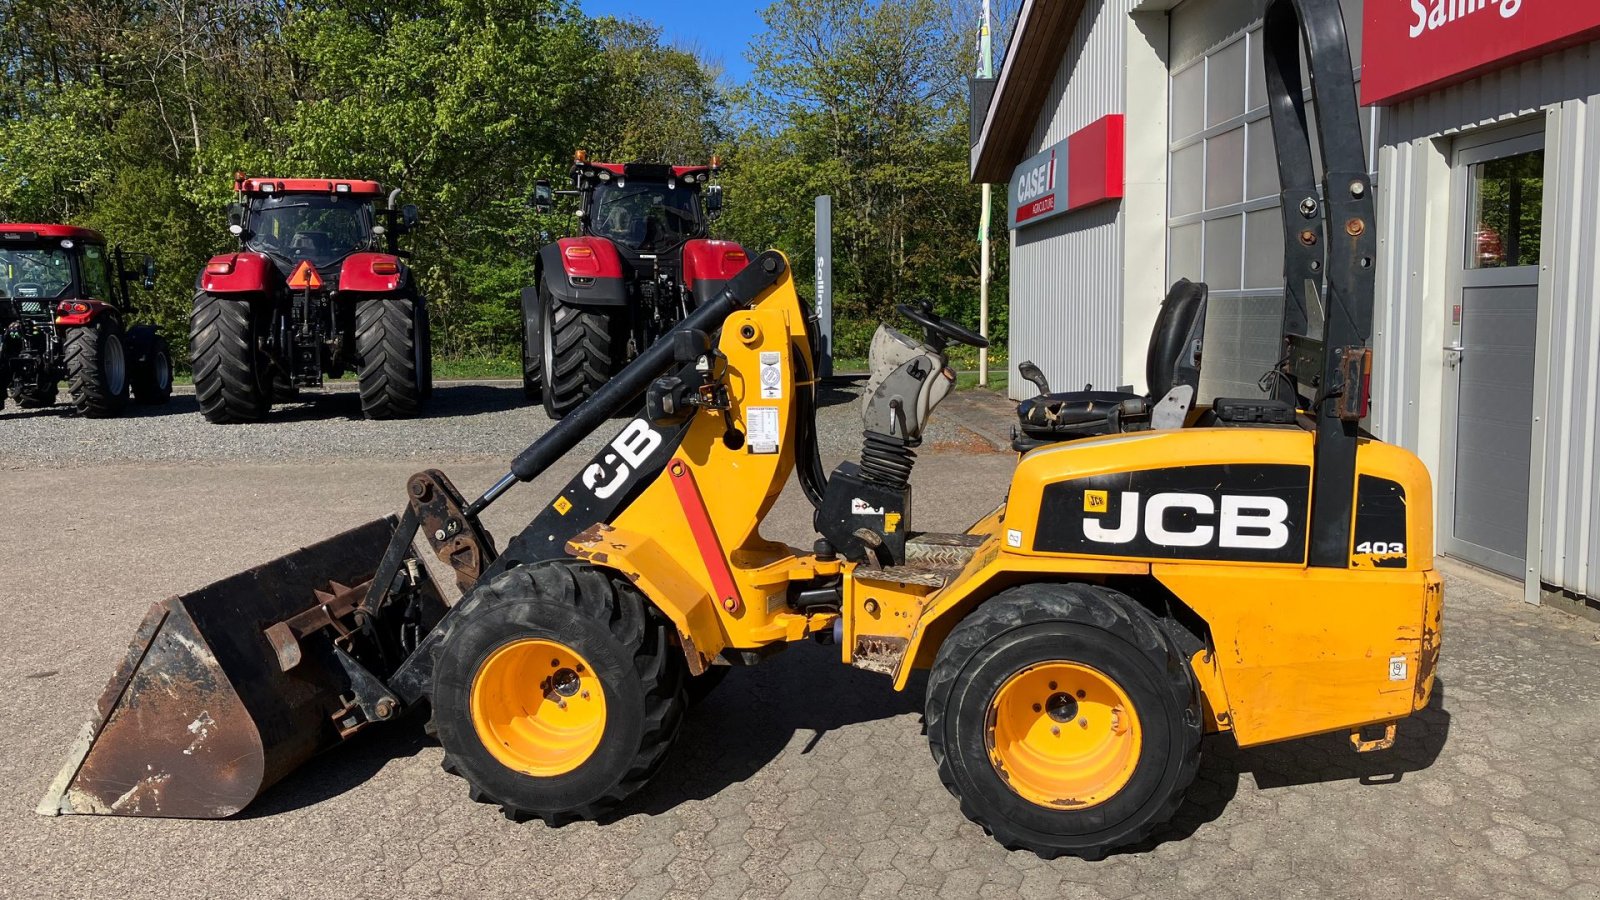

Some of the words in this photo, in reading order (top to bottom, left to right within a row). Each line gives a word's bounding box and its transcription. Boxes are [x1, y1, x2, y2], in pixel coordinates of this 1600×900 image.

[1018, 164, 1045, 203] CASE
[1033, 197, 1054, 214] AGRICULTURE
[1083, 491, 1289, 549] JCB
[1356, 541, 1404, 555] 403
